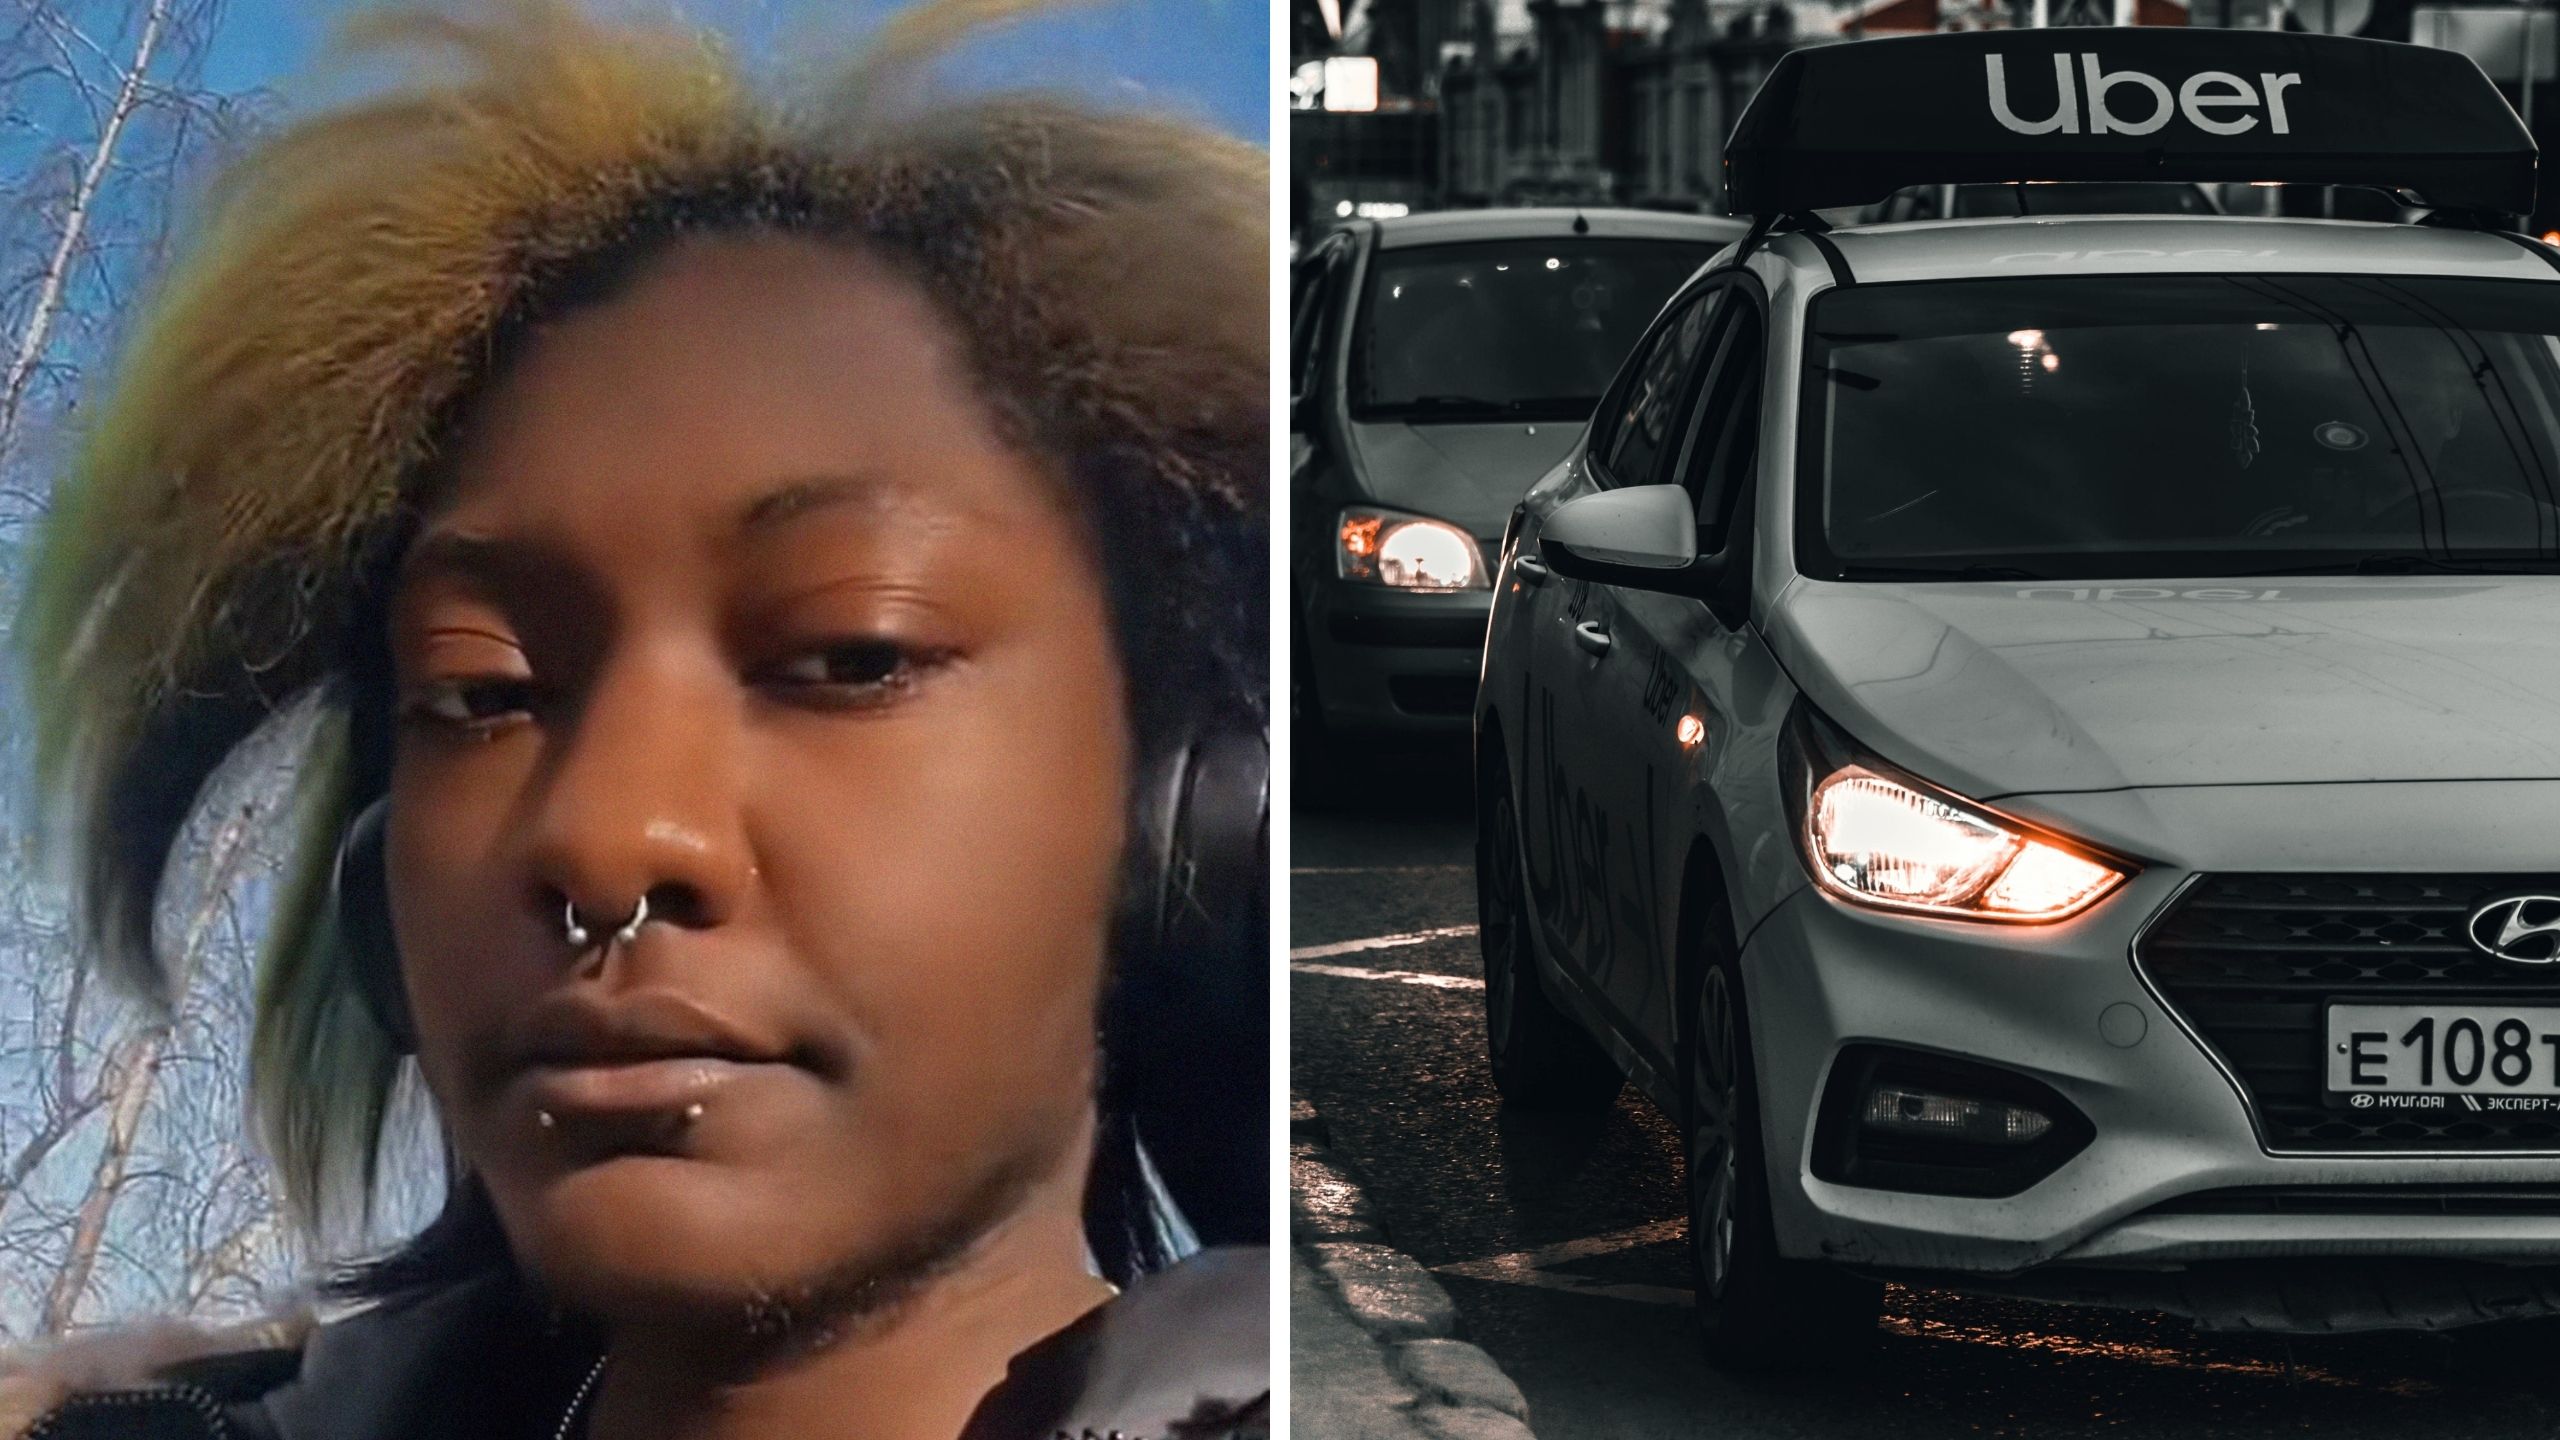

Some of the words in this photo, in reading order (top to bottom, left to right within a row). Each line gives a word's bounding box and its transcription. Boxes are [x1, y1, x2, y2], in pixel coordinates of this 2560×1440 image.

[1985, 53, 2301, 135] Uber
[1643, 643, 1680, 728] Uber
[1520, 671, 1616, 987] Uber
[2379, 1095, 2445, 1108] HYUNDAI
[2487, 1097, 2560, 1111] ЭКСПЕРТ-
